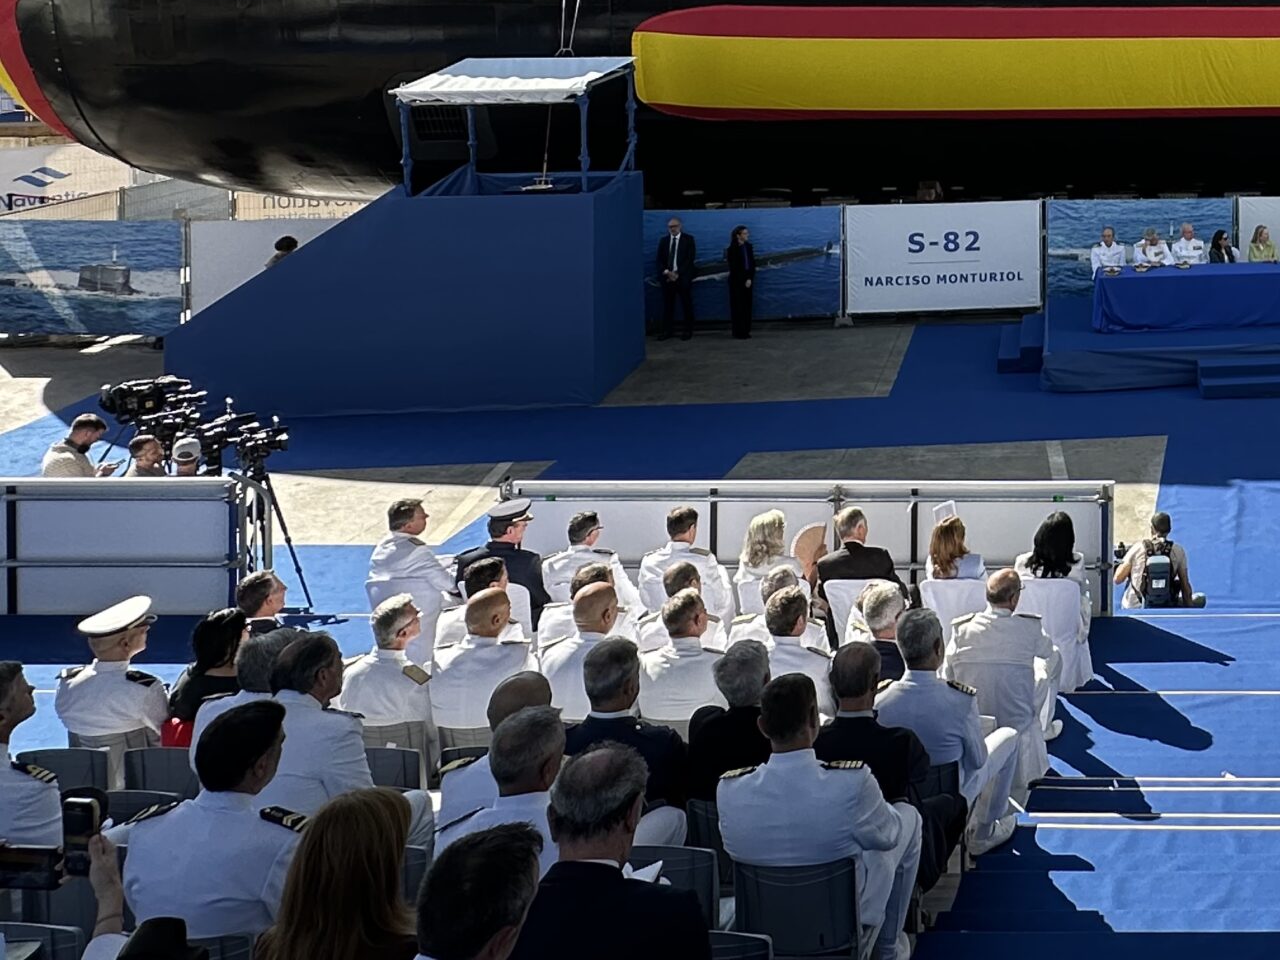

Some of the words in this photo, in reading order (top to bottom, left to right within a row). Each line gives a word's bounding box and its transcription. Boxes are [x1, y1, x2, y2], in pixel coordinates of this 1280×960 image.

[907, 230, 981, 254] S-82
[864, 275, 931, 287] NARCISO
[936, 270, 1024, 284] MONTURIOL
